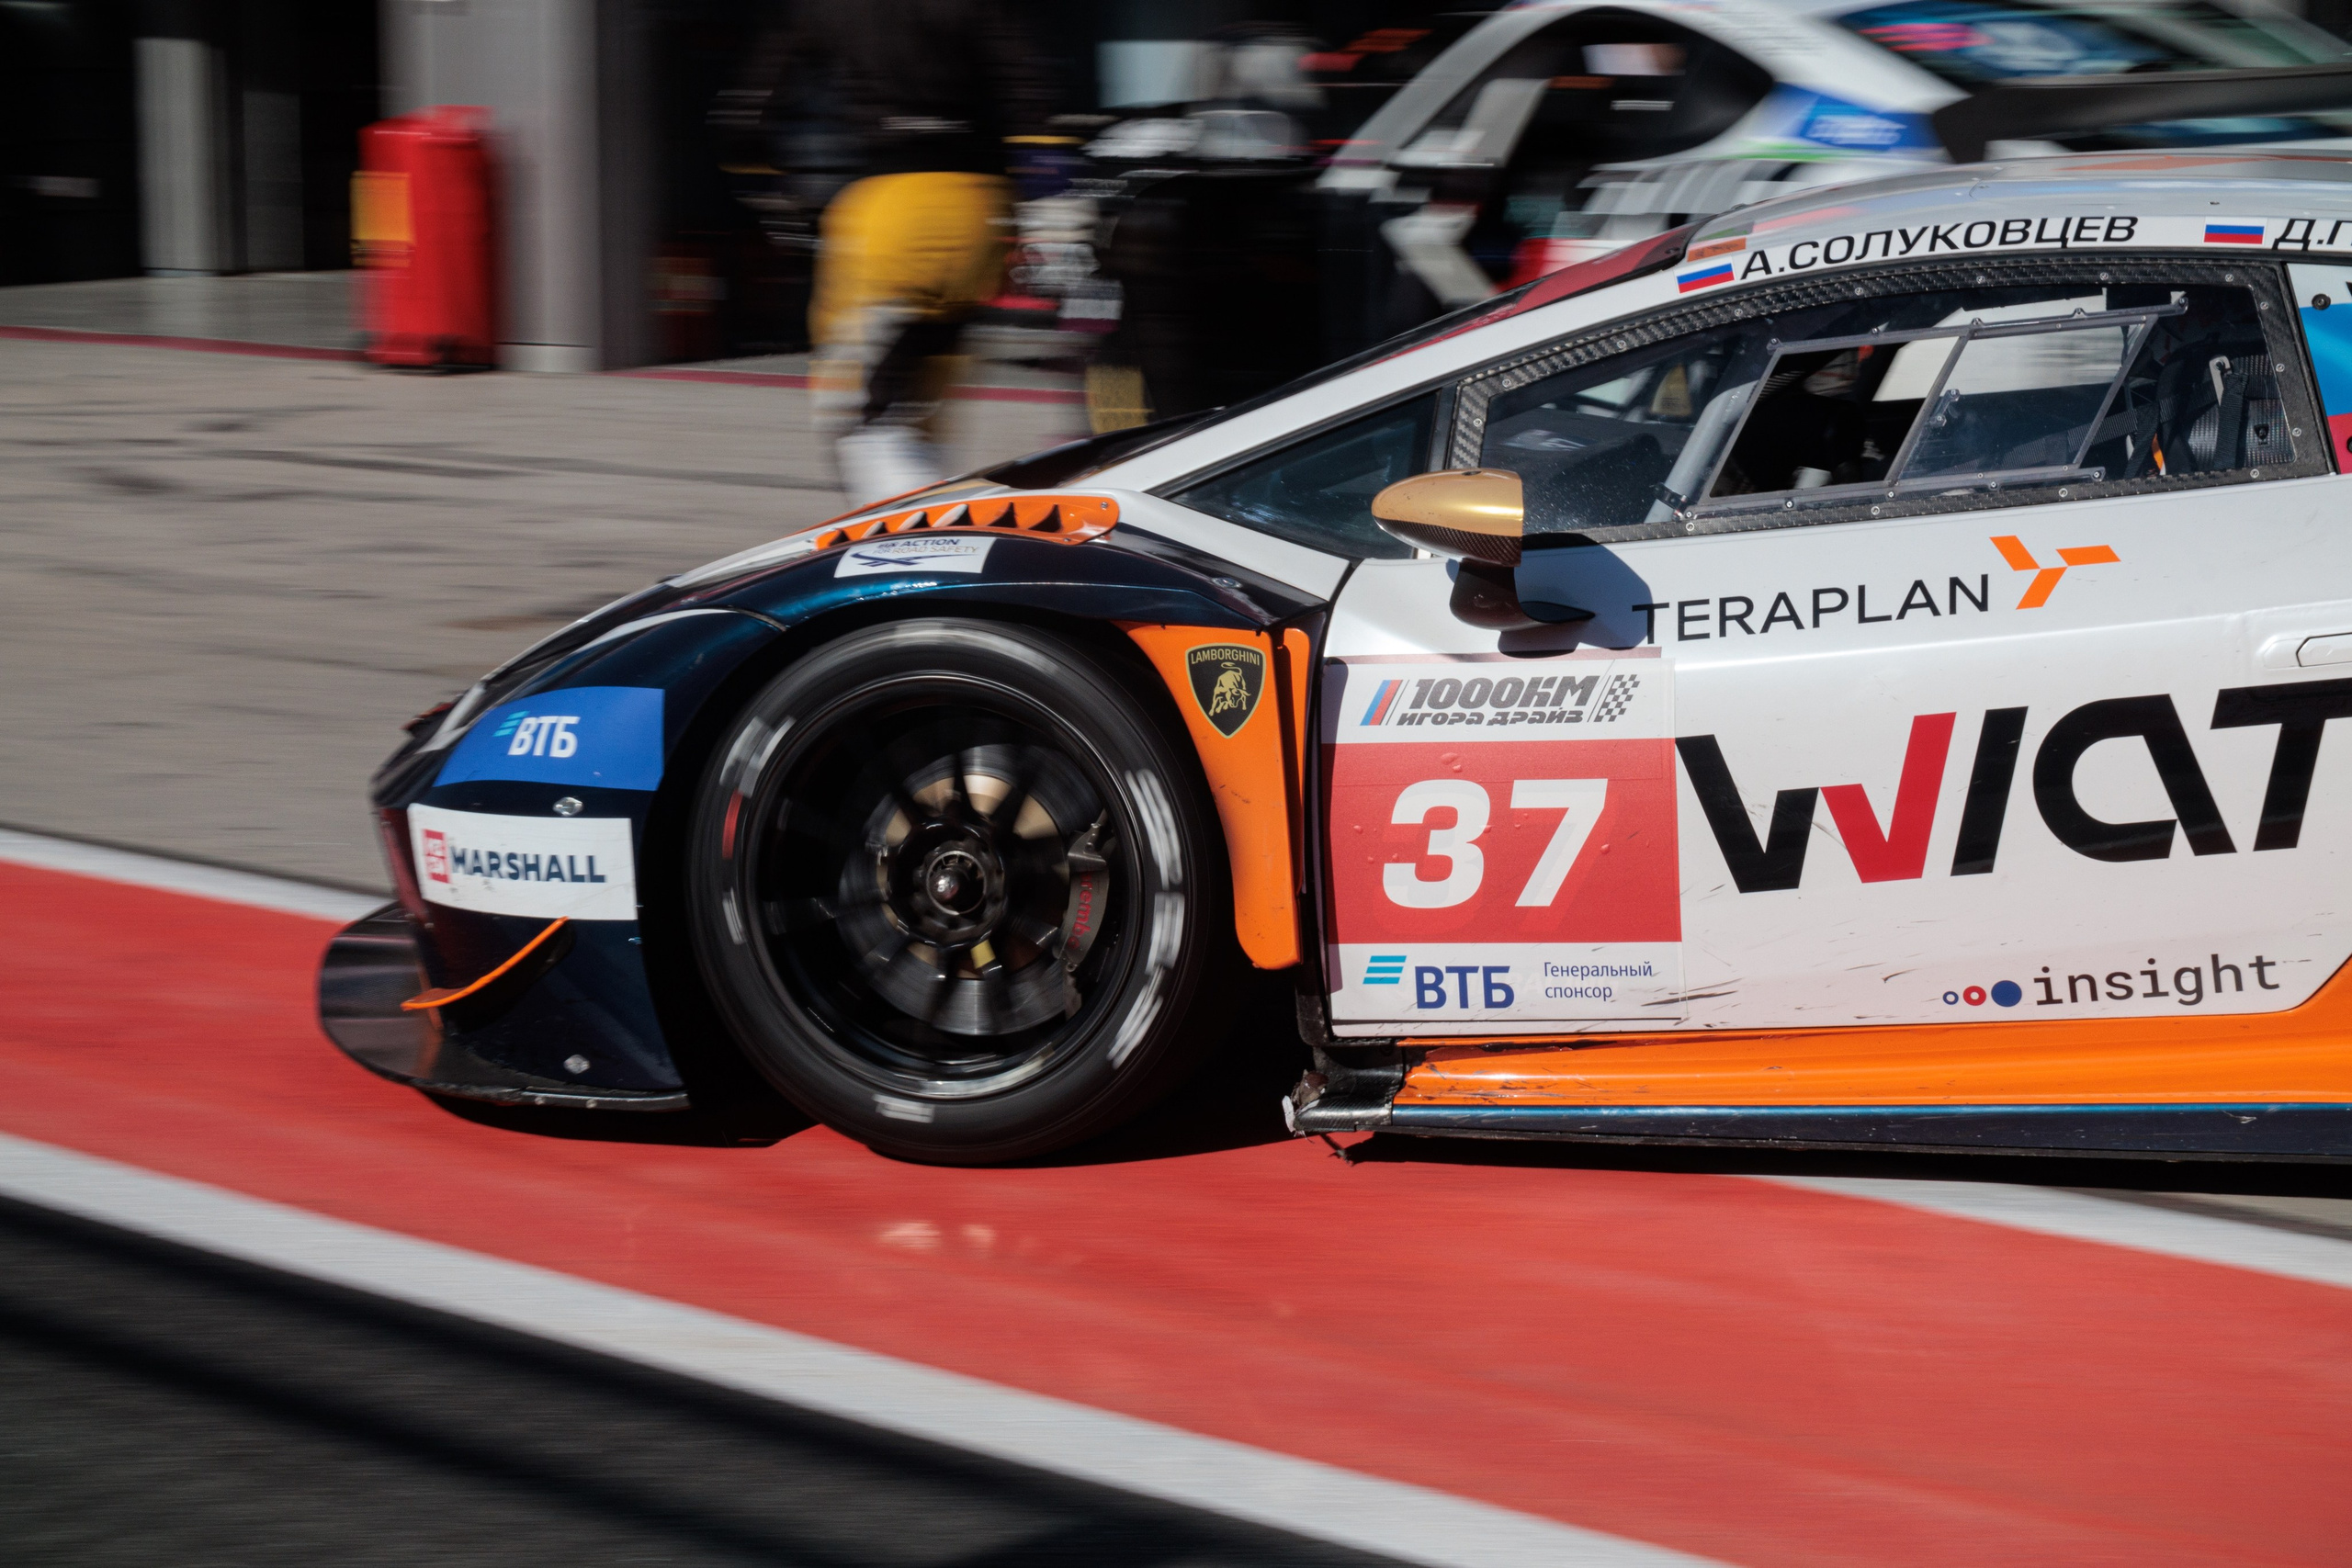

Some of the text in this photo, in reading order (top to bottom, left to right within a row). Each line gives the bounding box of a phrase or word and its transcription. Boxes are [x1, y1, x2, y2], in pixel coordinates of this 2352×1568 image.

[1740, 215, 2139, 279] А.СОЛУКОВЦЕВ
[892, 546, 928, 554] ROAD
[930, 545, 979, 554] SAFETY
[900, 538, 960, 547] ACTION
[1632, 573, 1989, 645] TERAPLAN
[1191, 648, 1261, 667] LAMBORGHINI
[508, 716, 582, 758] ВТБ
[1382, 778, 1609, 909] 37
[449, 845, 606, 884] MARSHALL
[1414, 964, 1515, 1010] ВТБ
[1544, 960, 1653, 980] Генеральный
[2034, 953, 2281, 1006] insight
[1544, 985, 1613, 1002] спонсор
